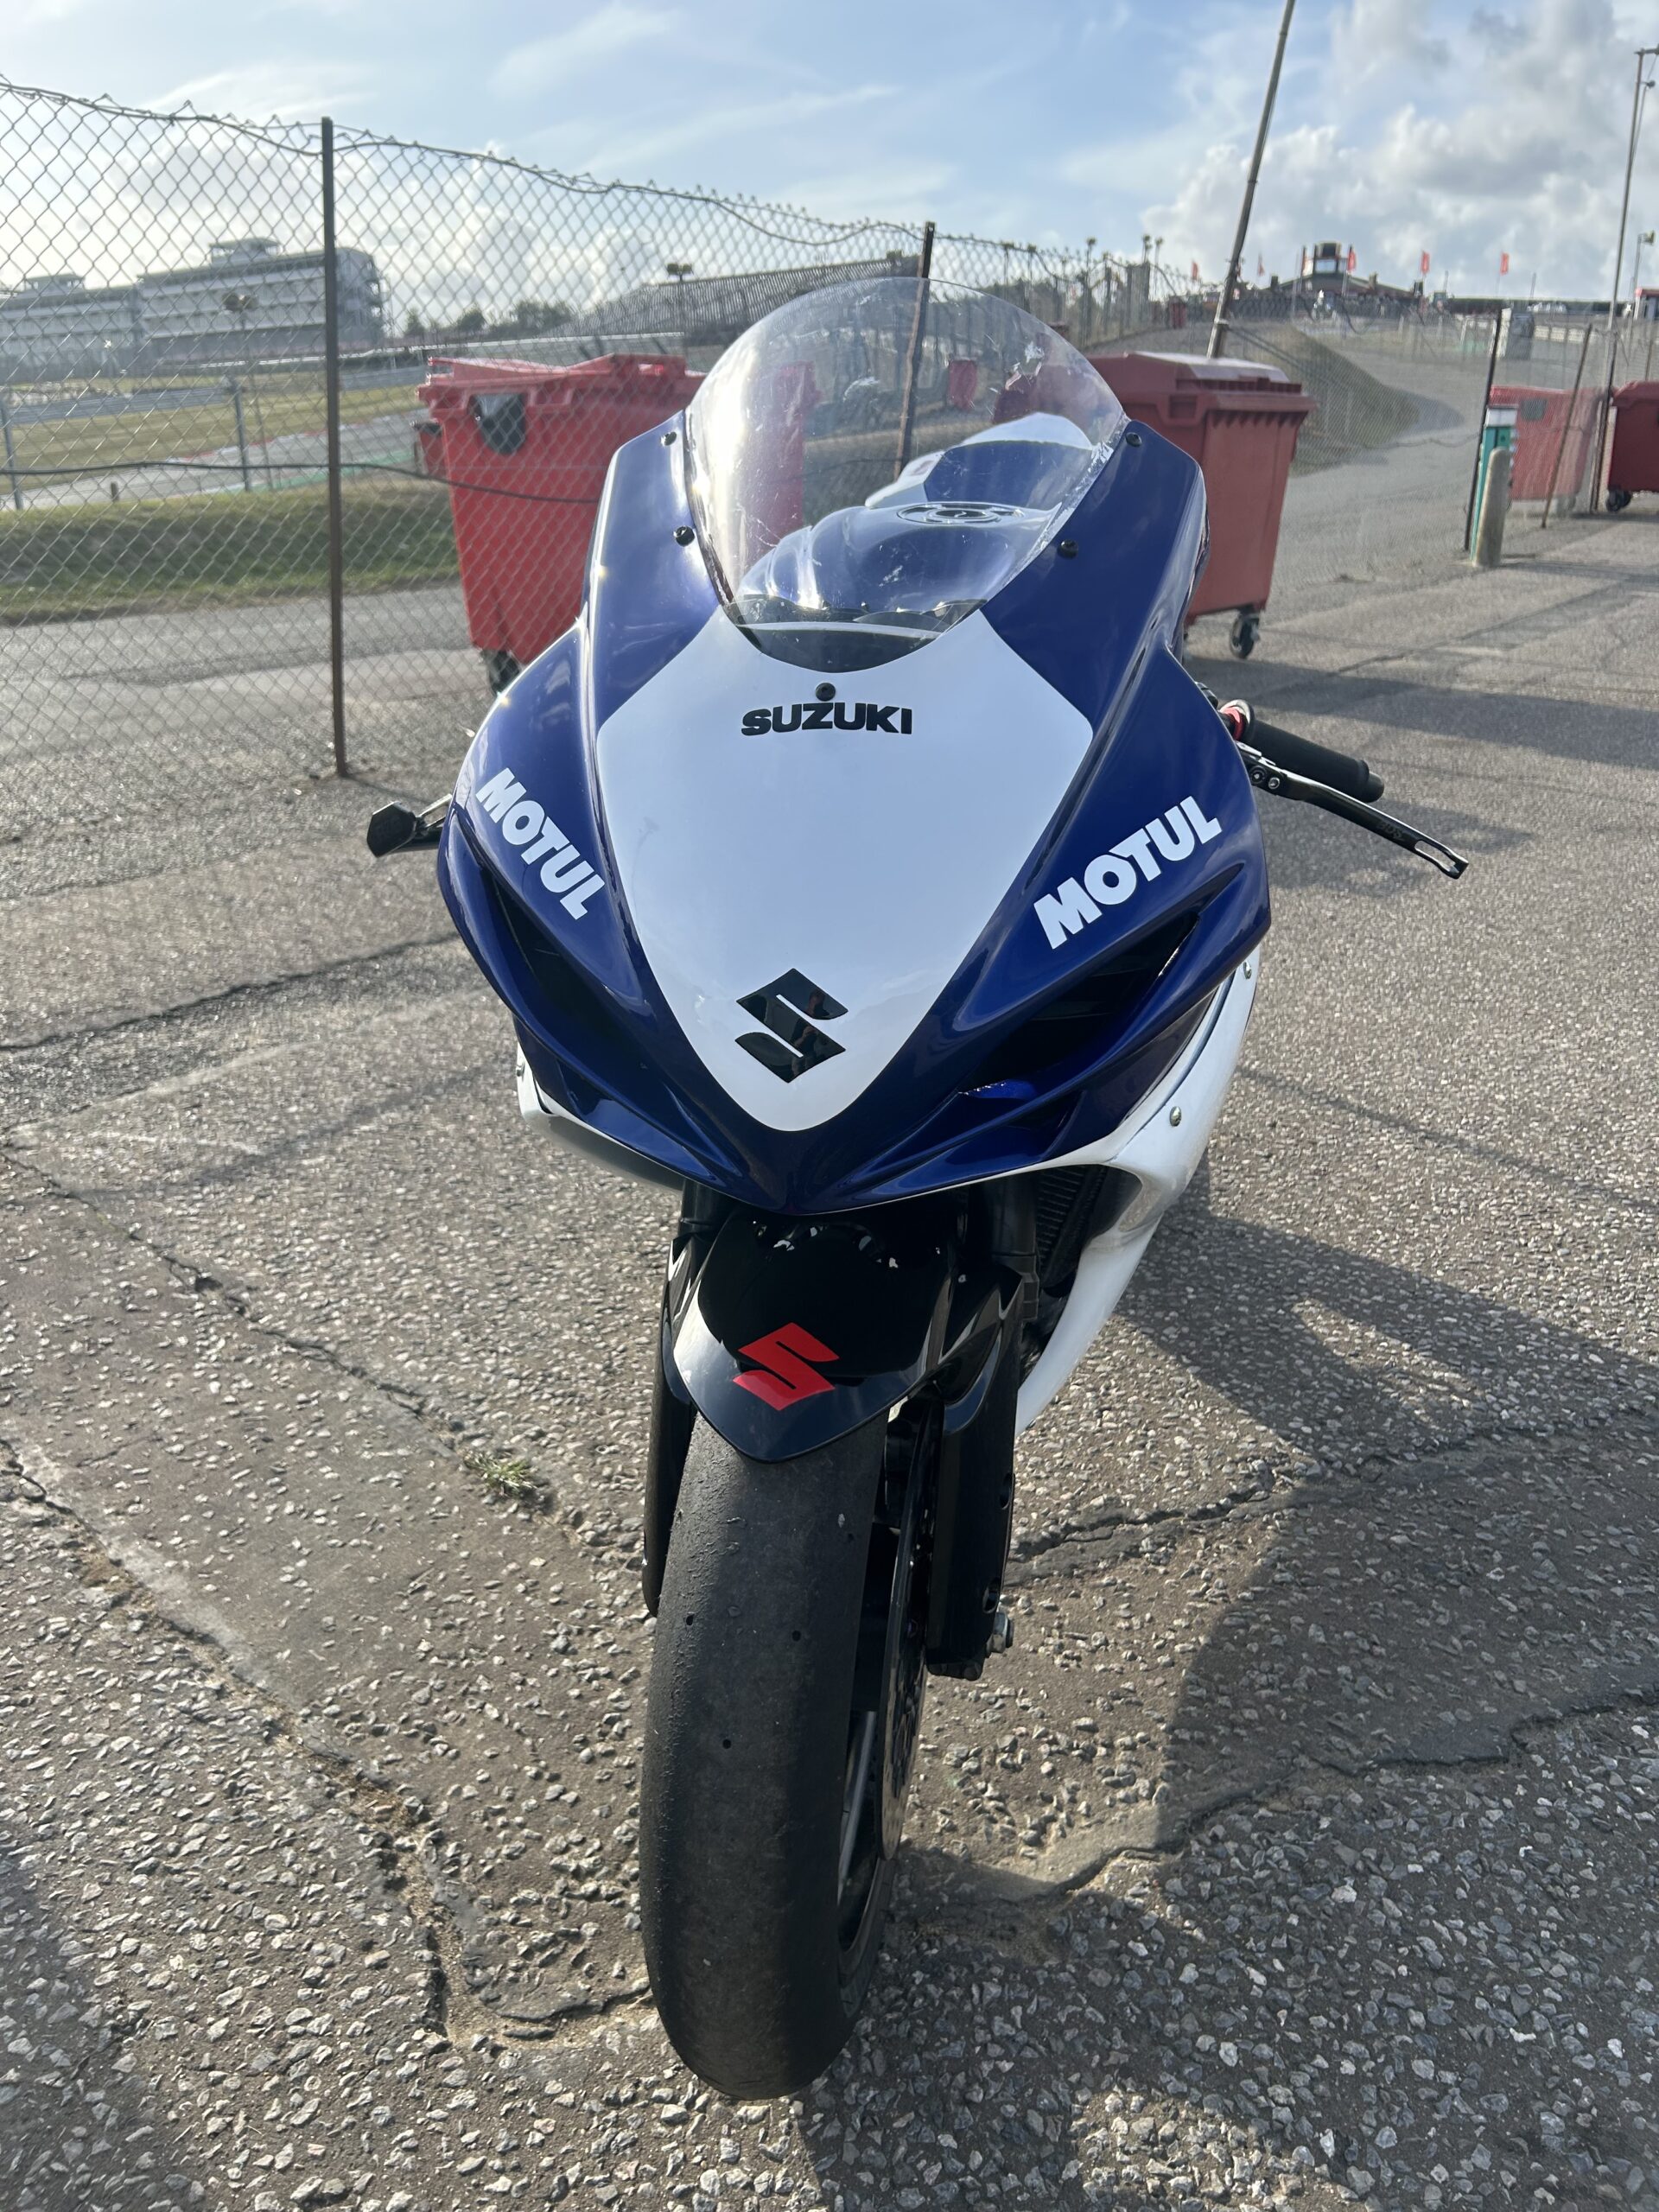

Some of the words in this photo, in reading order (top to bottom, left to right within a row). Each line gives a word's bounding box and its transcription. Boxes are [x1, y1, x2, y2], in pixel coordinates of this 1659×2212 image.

[741, 702, 913, 736] SUZUKI
[475, 767, 606, 920] MOTUL
[1033, 796, 1223, 950] MOTUL
